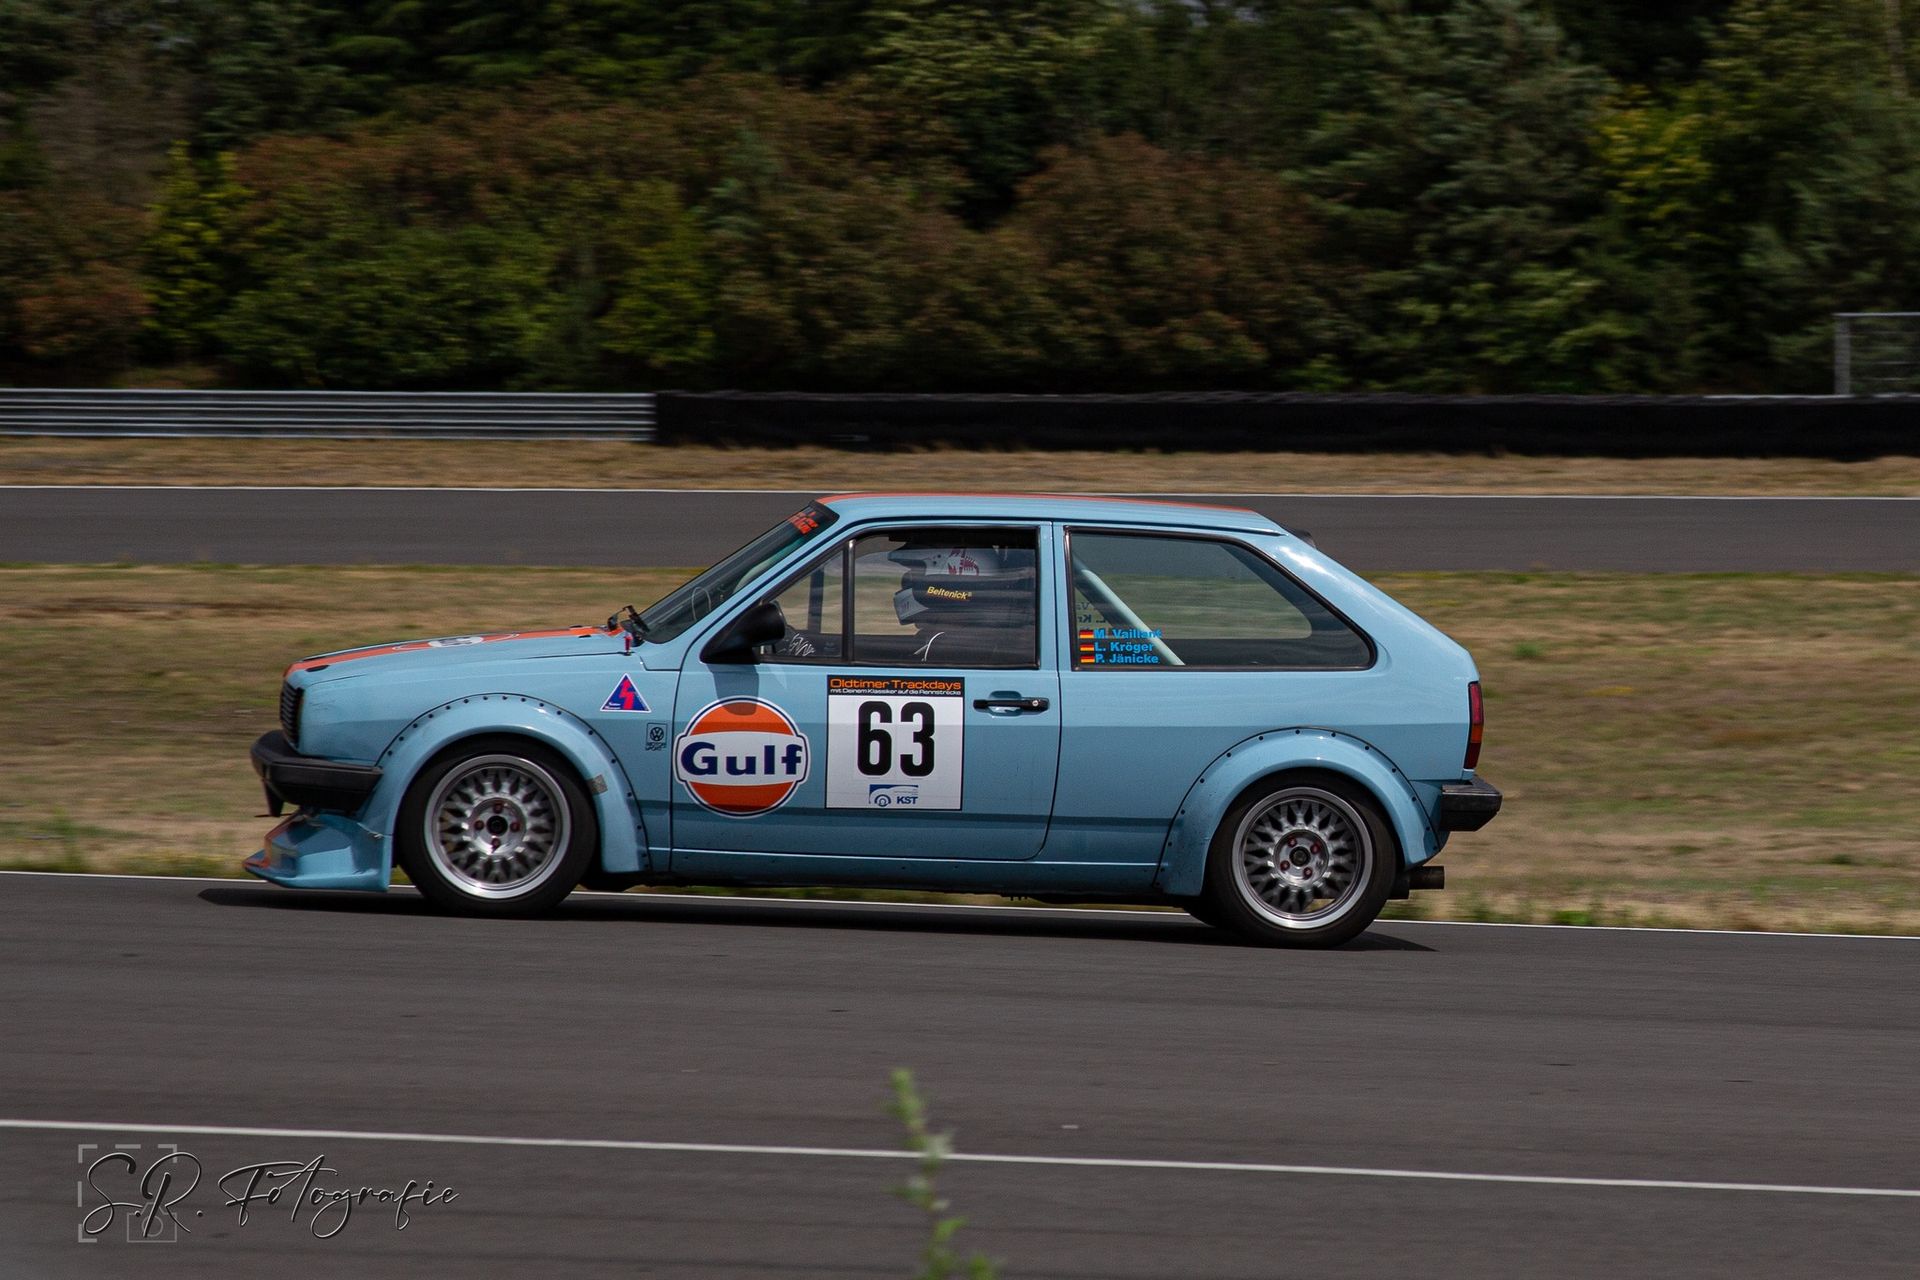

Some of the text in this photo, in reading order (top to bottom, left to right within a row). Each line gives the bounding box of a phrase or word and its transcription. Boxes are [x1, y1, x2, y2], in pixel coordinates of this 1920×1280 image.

[1094, 628, 1162, 639] M. Vaillant
[1094, 641, 1154, 653] L. Kröger
[1095, 653, 1159, 664] P. Jänicke
[830, 678, 961, 691] Oldtimer Trackdays
[857, 700, 935, 777] 63
[680, 741, 803, 776] Gulf
[896, 795, 918, 805] KST
